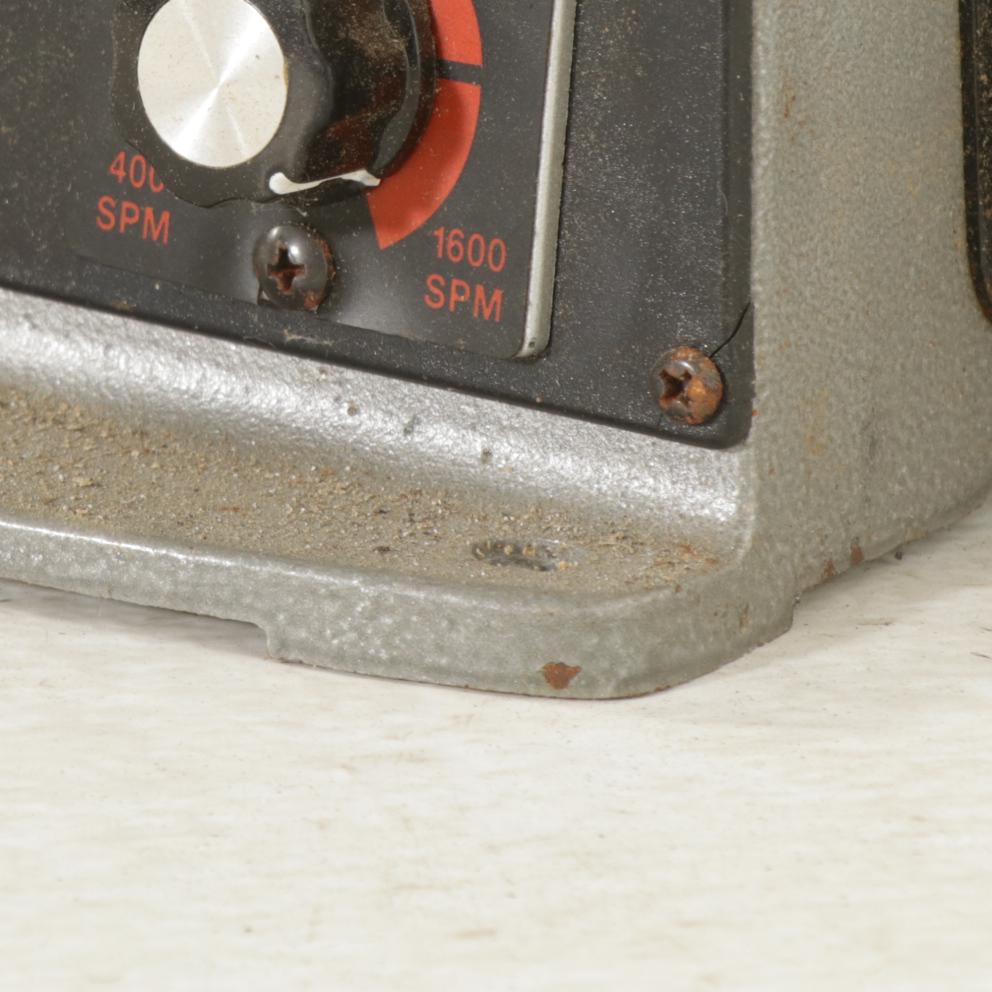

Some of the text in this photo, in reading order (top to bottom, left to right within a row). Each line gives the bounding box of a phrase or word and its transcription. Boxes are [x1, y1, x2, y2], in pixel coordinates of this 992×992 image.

[96, 196, 170, 244] SPM
[433, 226, 507, 273] 1600
[423, 274, 503, 322] SPM
